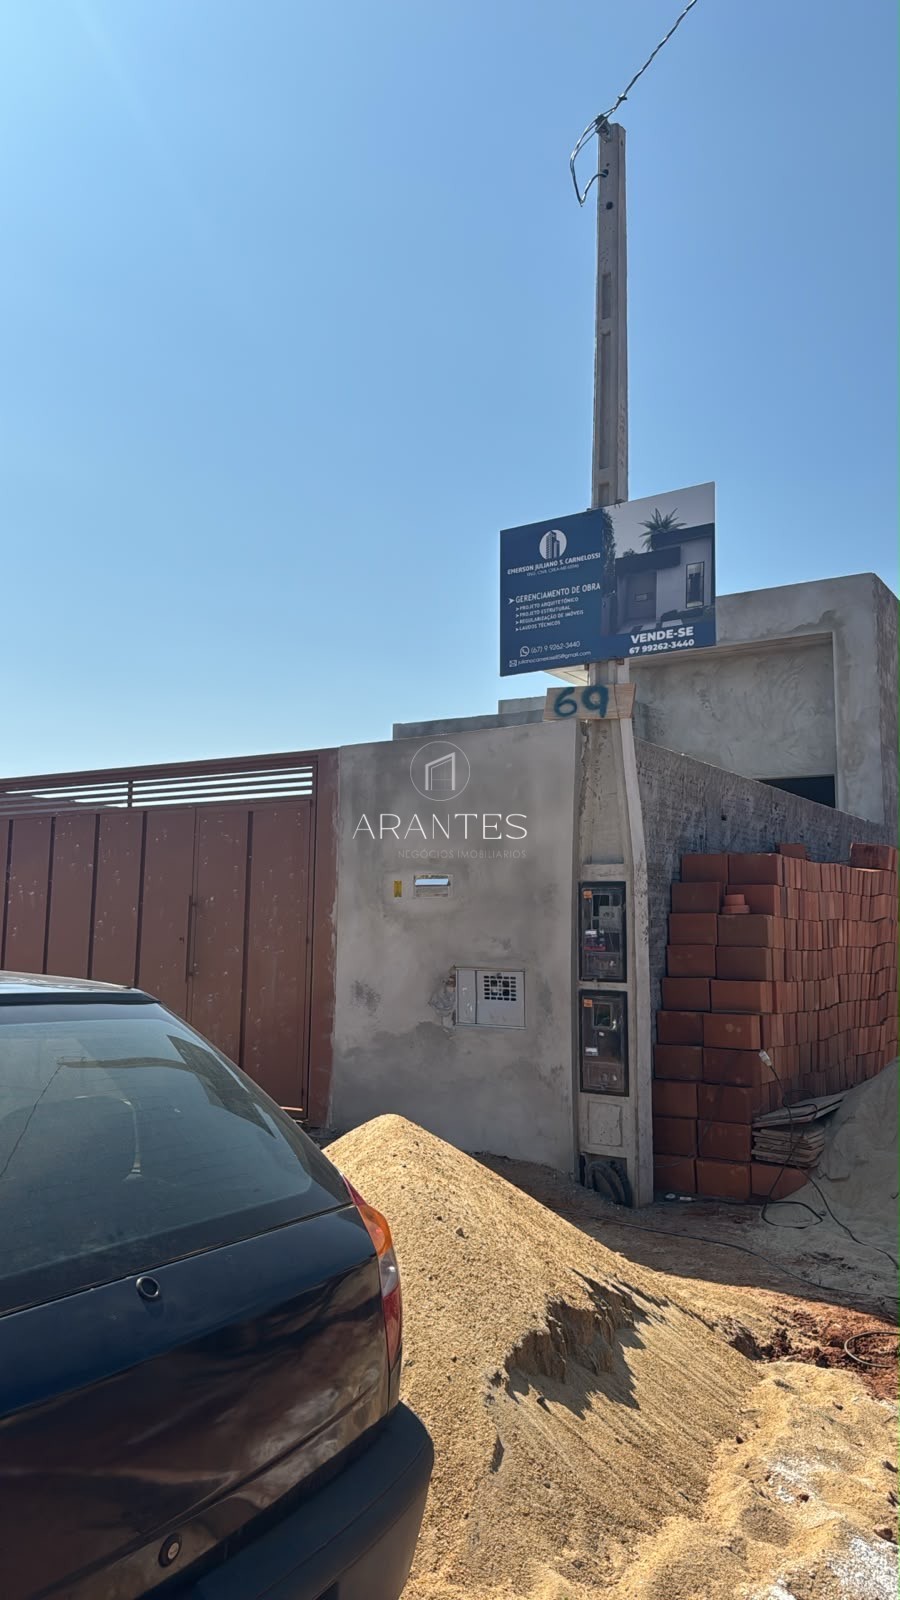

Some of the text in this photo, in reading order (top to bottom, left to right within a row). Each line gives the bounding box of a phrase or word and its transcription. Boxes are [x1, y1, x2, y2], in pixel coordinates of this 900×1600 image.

[507, 565, 533, 575] EMERSON
[535, 560, 558, 571] JULIANO
[565, 552, 601, 564] CARNELOSSI
[515, 582, 601, 604] GERENCIAMENTO DE OBRA
[519, 602, 540, 610] PROJETO
[519, 605, 571, 617] PROJETO ESTRUTURAL
[630, 626, 694, 644] VENDE-SE
[530, 645, 543, 654] (67)
[549, 640, 581, 651] 9262-3440
[629, 638, 695, 654] 67 99262-3440
[554, 685, 609, 718] 69
